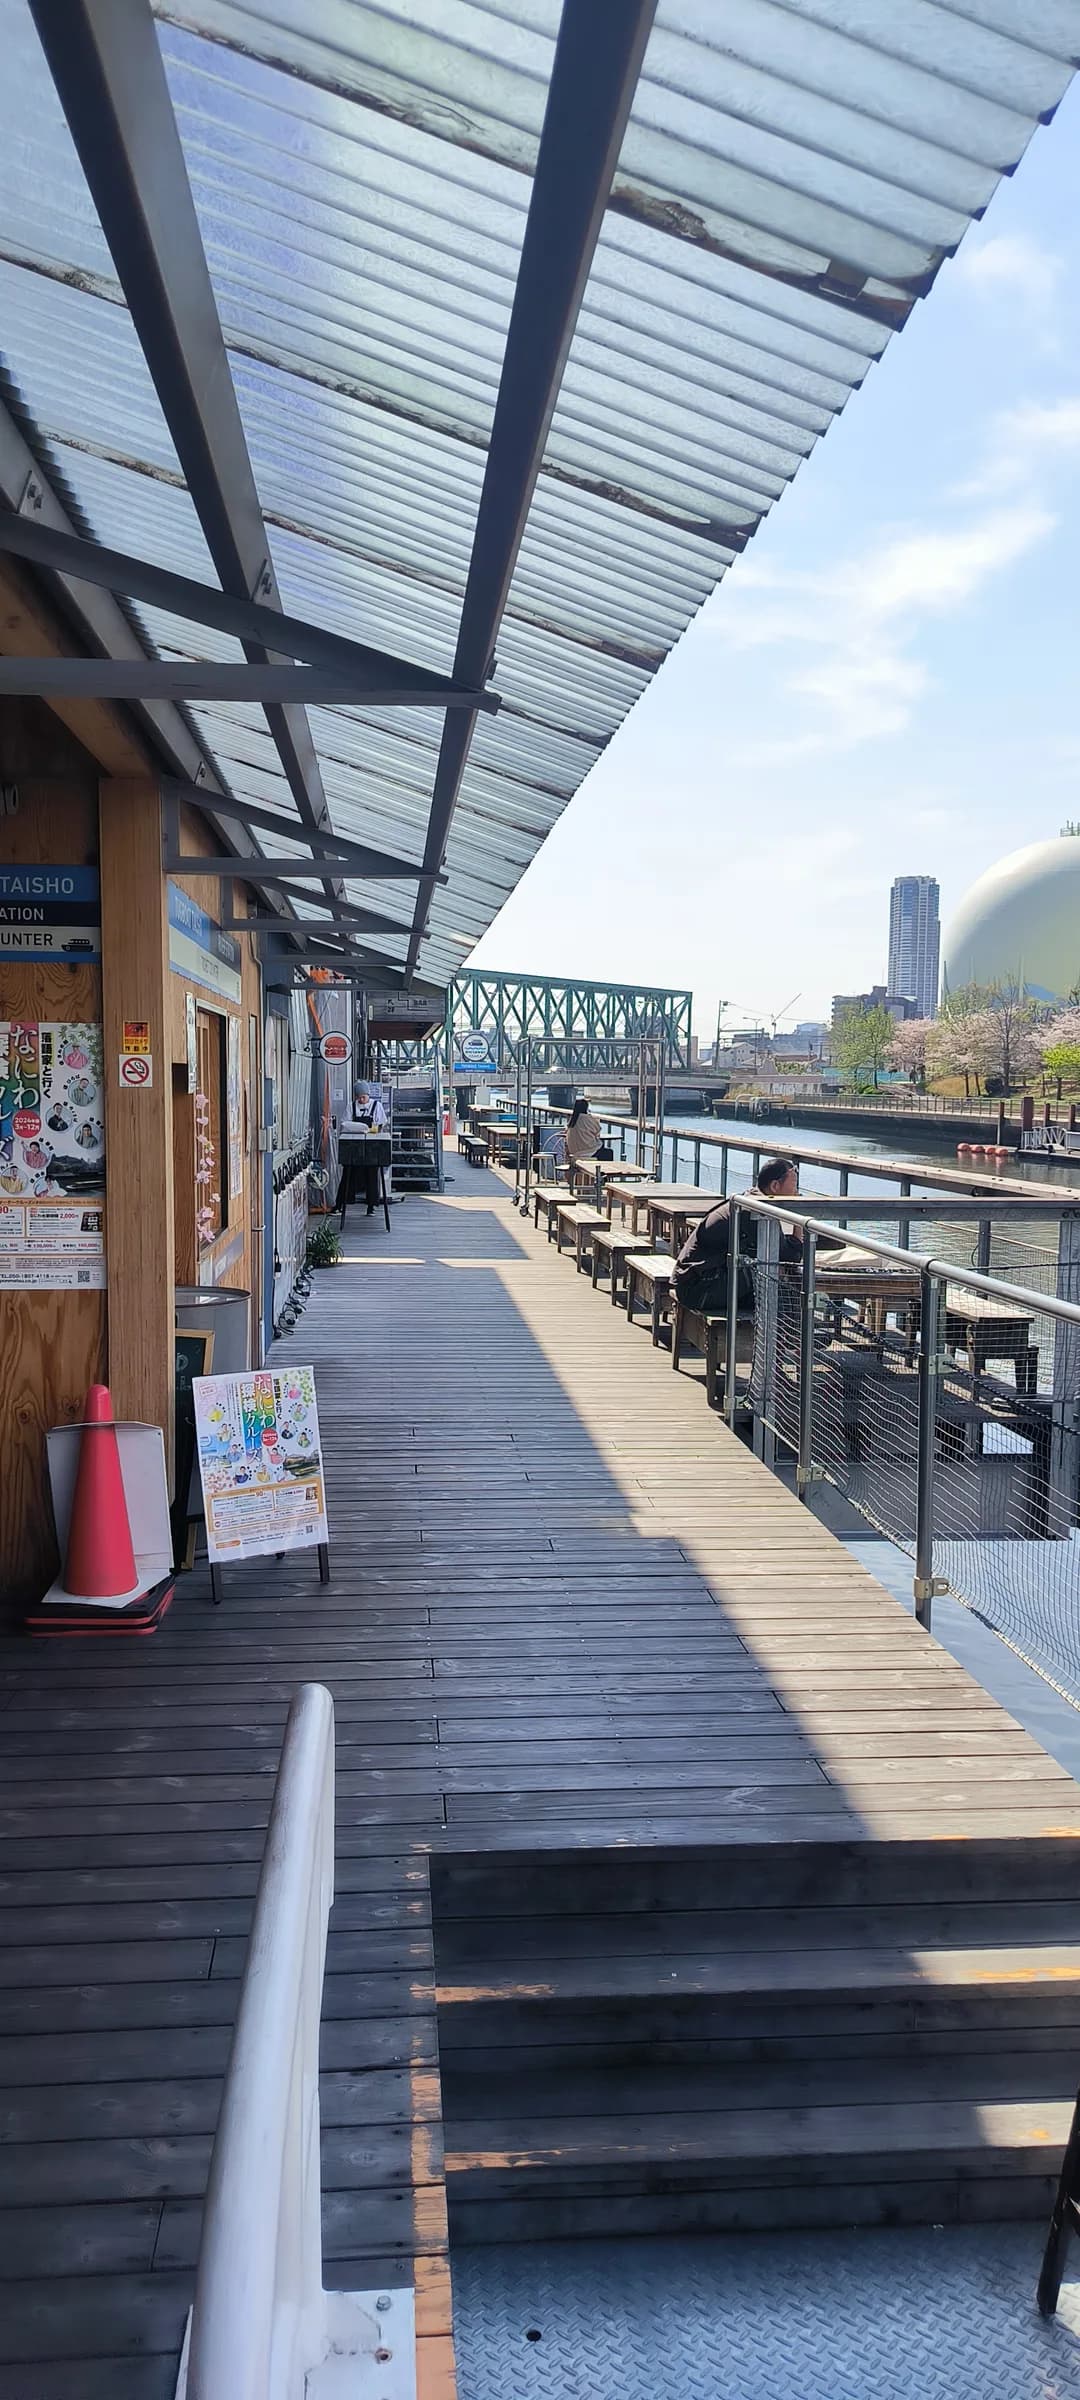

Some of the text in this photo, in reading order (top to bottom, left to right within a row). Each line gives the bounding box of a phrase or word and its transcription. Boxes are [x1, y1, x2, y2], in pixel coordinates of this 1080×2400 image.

[0, 876, 74, 894] TAISHO
[0, 907, 44, 920] ATION
[1, 933, 53, 946] UNTER
[11, 1025, 39, 1109] なにわ
[41, 1032, 53, 1099] 落語家と行く
[255, 1375, 275, 1429] なにわ
